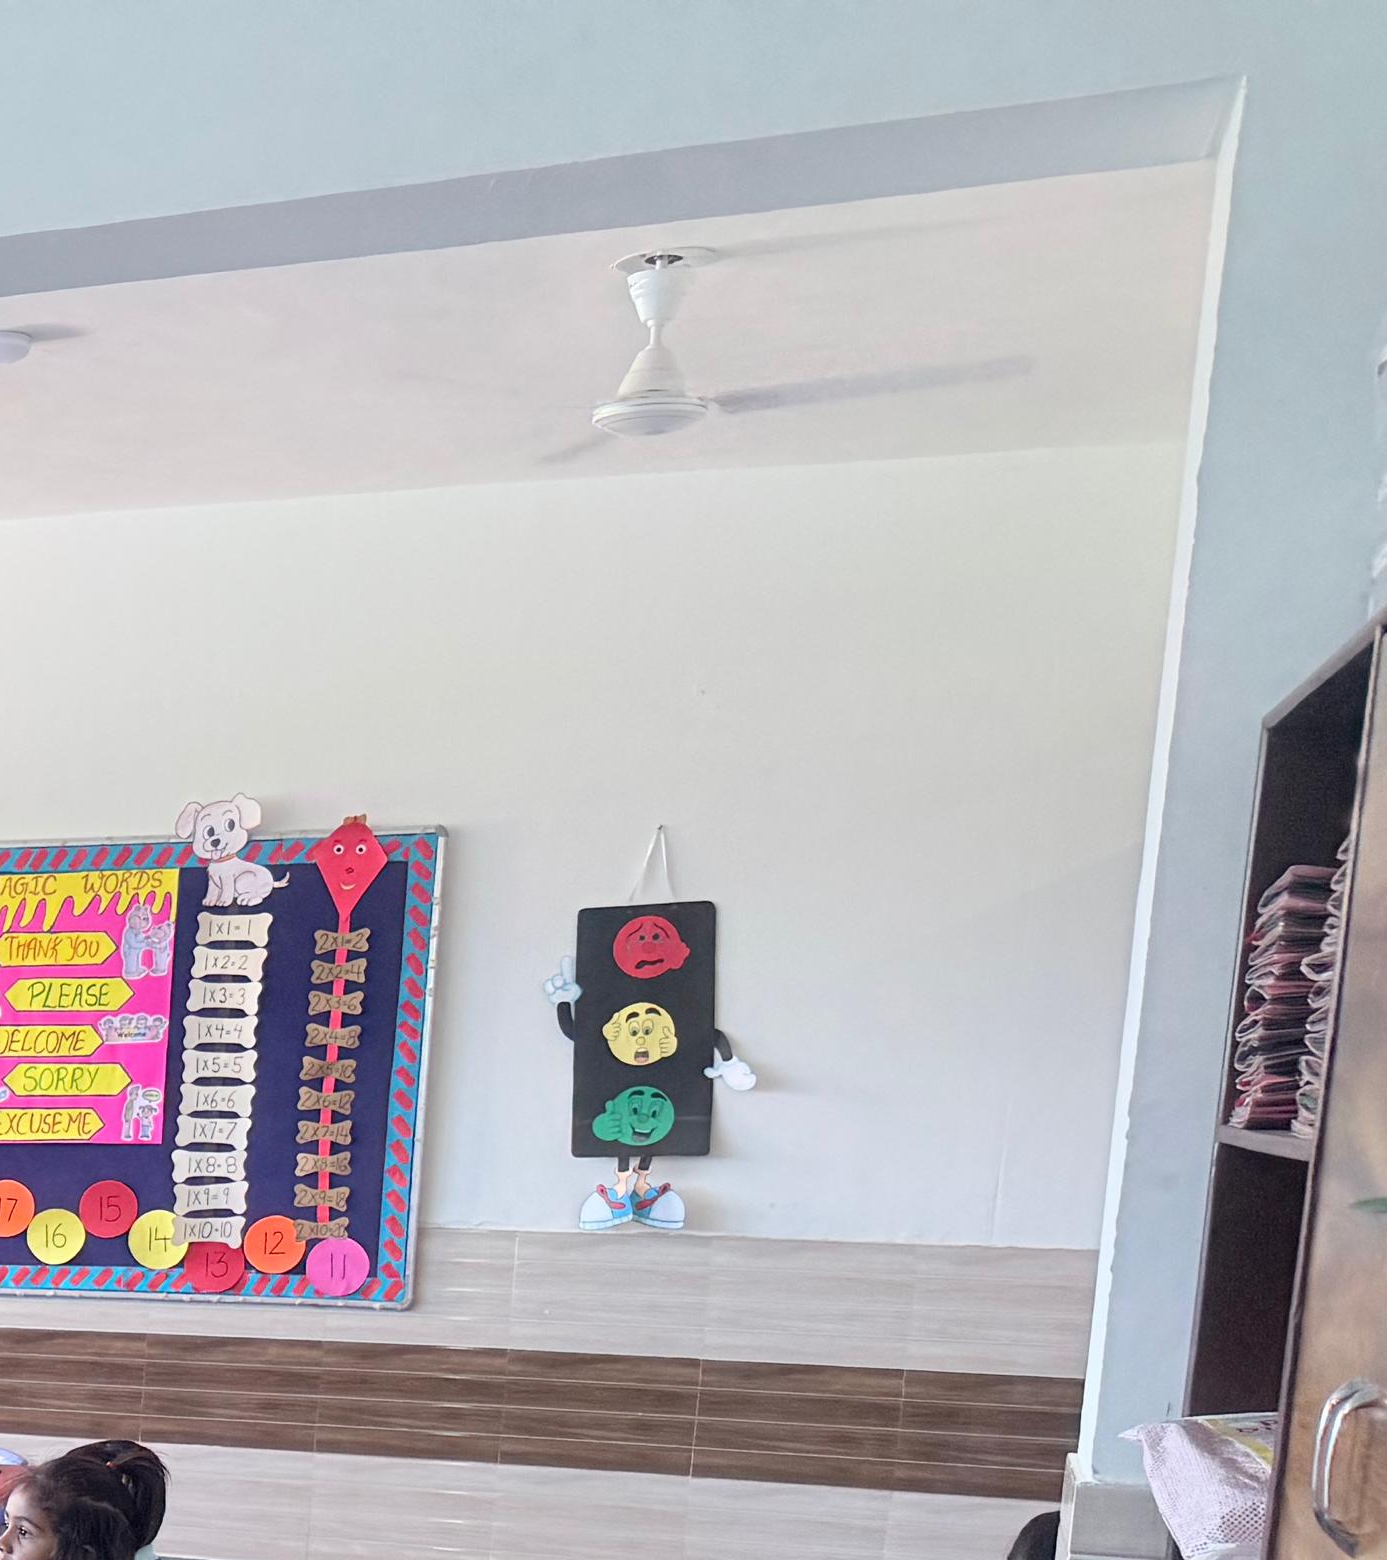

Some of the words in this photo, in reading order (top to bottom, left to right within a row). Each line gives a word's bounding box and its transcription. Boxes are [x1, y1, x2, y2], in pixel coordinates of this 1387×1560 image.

[82, 871, 163, 896] WORDS
[5, 935, 60, 962] THANK
[67, 937, 100, 961] YOU
[28, 981, 110, 1008] PLEASE
[23, 1067, 100, 1092] SORRY
[99, 1196, 122, 1222] 15
[45, 1225, 68, 1249] 16
[148, 1227, 171, 1252] 14
[263, 1232, 286, 1255] 12
[205, 1252, 229, 1278] 13
[330, 1252, 346, 1280] 11
